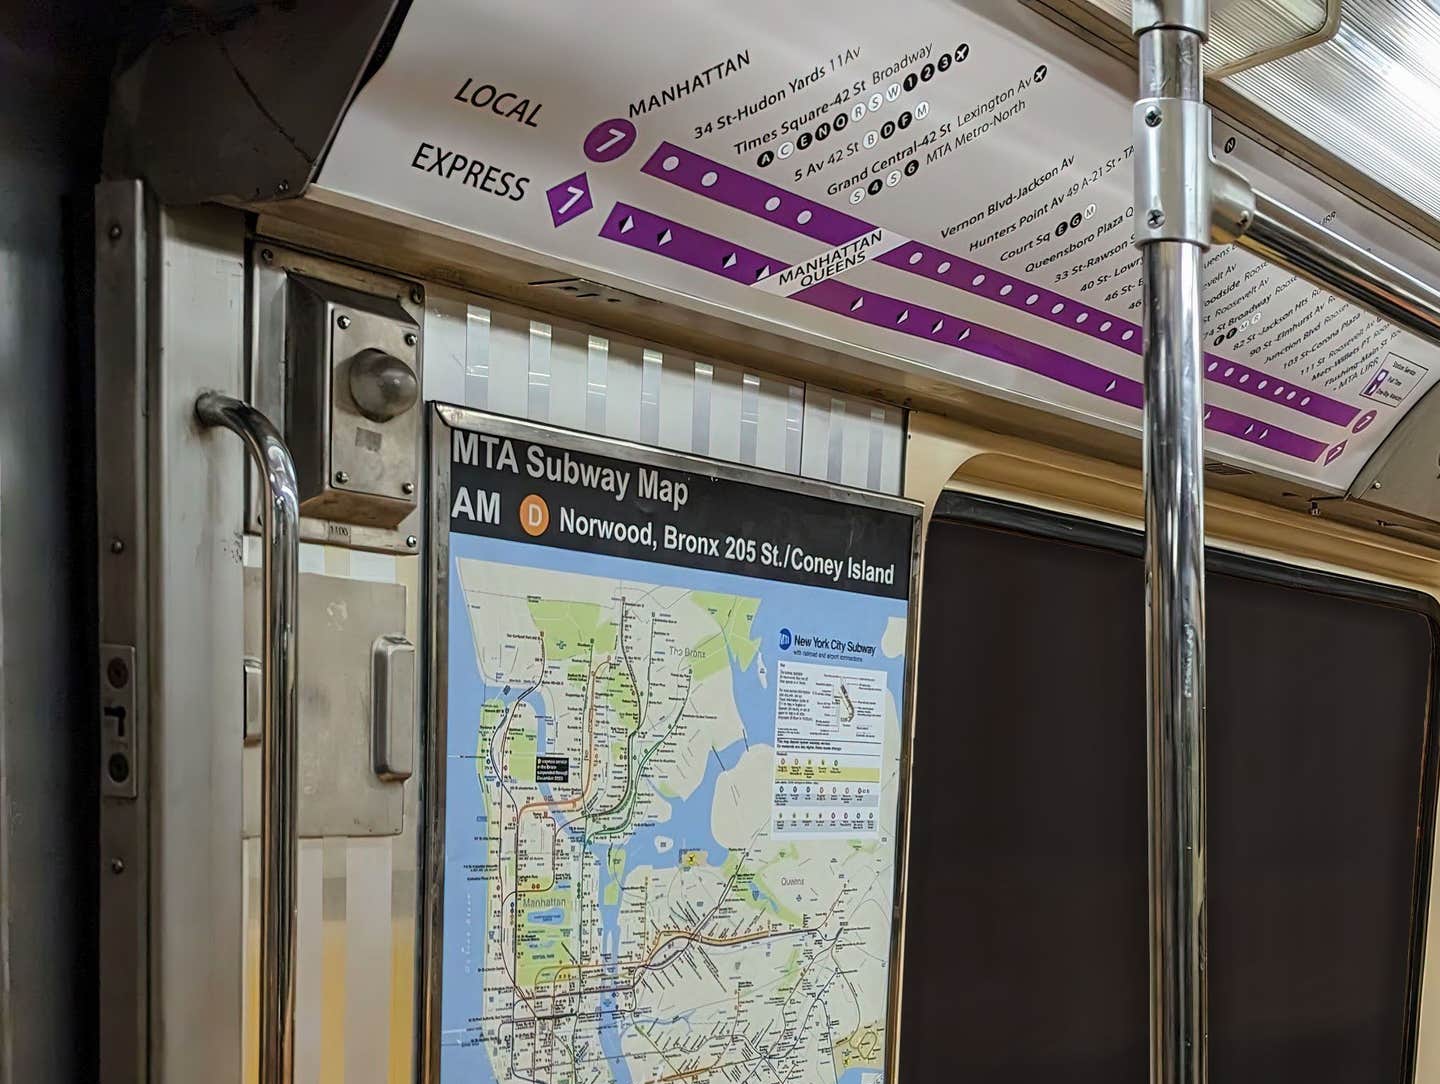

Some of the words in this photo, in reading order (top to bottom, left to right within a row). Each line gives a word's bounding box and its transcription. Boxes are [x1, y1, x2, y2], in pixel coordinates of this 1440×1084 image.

[453, 77, 543, 128] LOCAL
[628, 49, 751, 118] MANHATTAN
[693, 122, 714, 140] 34
[788, 66, 826, 93] Yards
[780, 88, 851, 136] Square-42
[852, 80, 868, 98] St
[871, 42, 934, 86] Broadway
[595, 127, 627, 153] 7
[827, 167, 869, 196] Grand
[871, 131, 937, 174] Central-42
[939, 123, 952, 138] St
[957, 86, 1016, 128] Lexington
[1016, 75, 1033, 93] Av
[926, 142, 952, 165] MTA
[954, 100, 1027, 152] Metro-North
[411, 141, 531, 202] EXPRESS
[794, 169, 803, 182] 5
[805, 159, 826, 177] Av
[826, 149, 845, 166] 42
[845, 142, 860, 159] St
[557, 185, 585, 215] 7
[940, 211, 986, 239] Vernon
[987, 167, 1060, 216] Blvd-Jackson
[1060, 154, 1076, 171] Av
[968, 224, 1018, 252] Hunters
[1018, 202, 1049, 228] Point
[1050, 194, 1066, 210] Av
[1066, 183, 1080, 198] 49
[1105, 158, 1117, 174] St
[778, 230, 883, 286] MANHATTAN
[800, 250, 866, 287] QUEENS
[1000, 241, 1034, 263] Court
[1036, 232, 1051, 248] Sq
[1025, 233, 1095, 274] Queensboro
[1097, 216, 1124, 238] Plaza
[1054, 270, 1069, 283] 33
[1071, 240, 1128, 276] St-Rawson
[1080, 280, 1095, 292] 40
[1104, 290, 1119, 302] 46
[452, 428, 520, 475] MTA
[526, 444, 631, 502] Subway
[637, 467, 690, 512] Map
[450, 486, 502, 526] AM
[528, 504, 544, 528] D
[558, 505, 658, 552] Norwood,
[663, 528, 721, 558] Bronx
[725, 534, 757, 565] 205
[847, 553, 895, 587] Island
[794, 634, 812, 647] New
[813, 636, 830, 650] York
[830, 639, 846, 653] City
[847, 641, 877, 656] Subway
